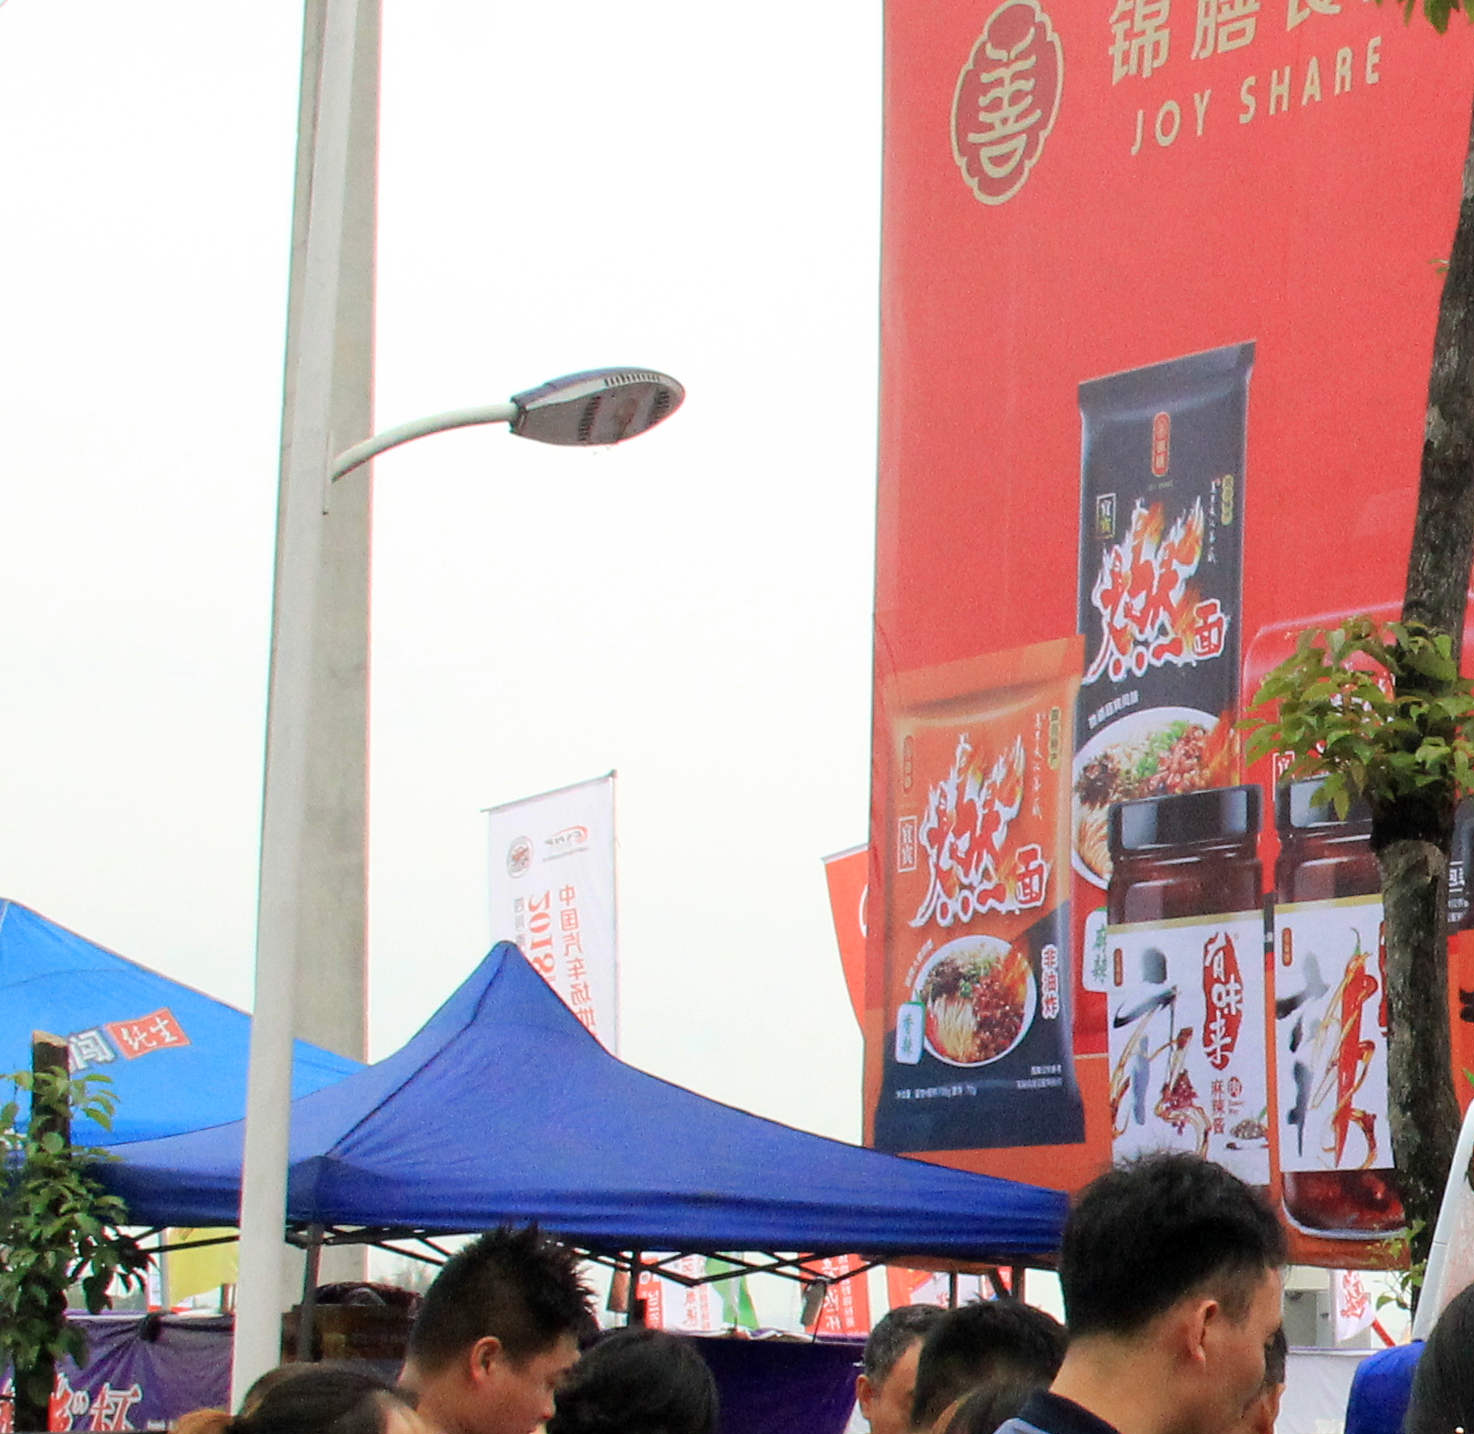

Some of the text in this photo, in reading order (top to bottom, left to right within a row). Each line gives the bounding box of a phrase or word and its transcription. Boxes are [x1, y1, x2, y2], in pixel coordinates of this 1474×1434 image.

[1130, 36, 1382, 156] JOY SHARE
[121, 1016, 178, 1052] 纯生
[1203, 931, 1243, 1064] 有味来
